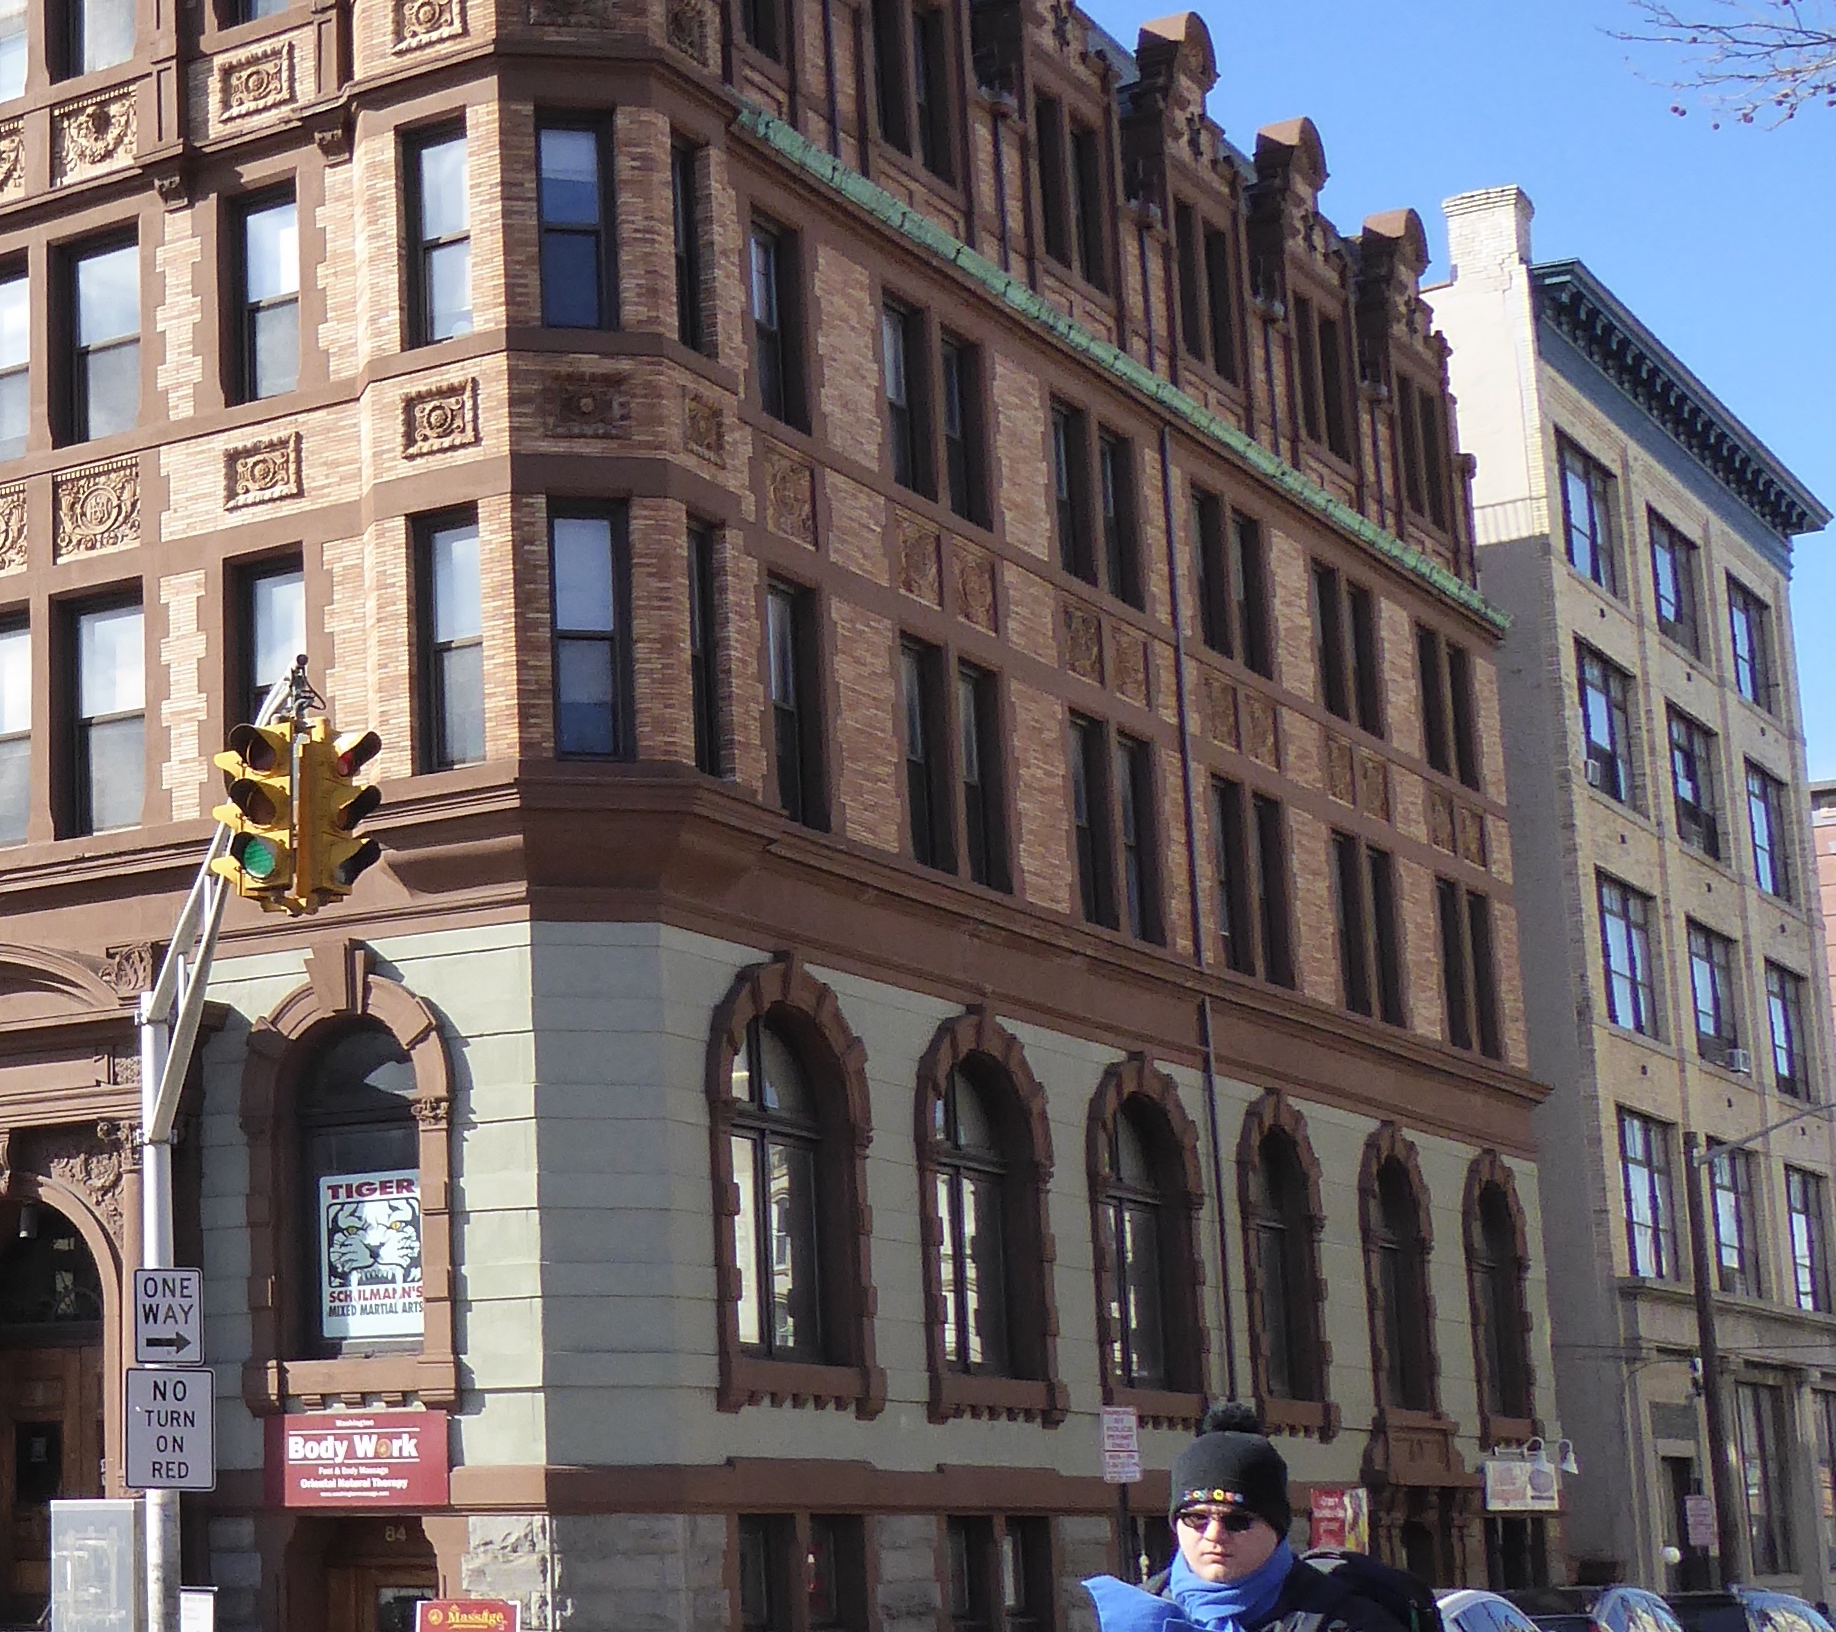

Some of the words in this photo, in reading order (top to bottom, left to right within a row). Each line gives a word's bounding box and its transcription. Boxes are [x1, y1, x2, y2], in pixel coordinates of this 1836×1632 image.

[327, 1179, 415, 1200] TIGER
[144, 1277, 192, 1298] ONE
[143, 1303, 193, 1325] WAY
[328, 1304, 357, 1317] MIXED
[360, 1302, 398, 1315] MARTIAL
[402, 1300, 423, 1313] ARTS
[153, 1380, 186, 1402] NO
[145, 1410, 195, 1427] TURN
[156, 1436, 184, 1453] ON
[288, 1435, 348, 1463] Body
[353, 1433, 419, 1458] Work
[152, 1462, 189, 1478] RED
[385, 1525, 407, 1542] 84
[447, 1608, 504, 1627] Massage
